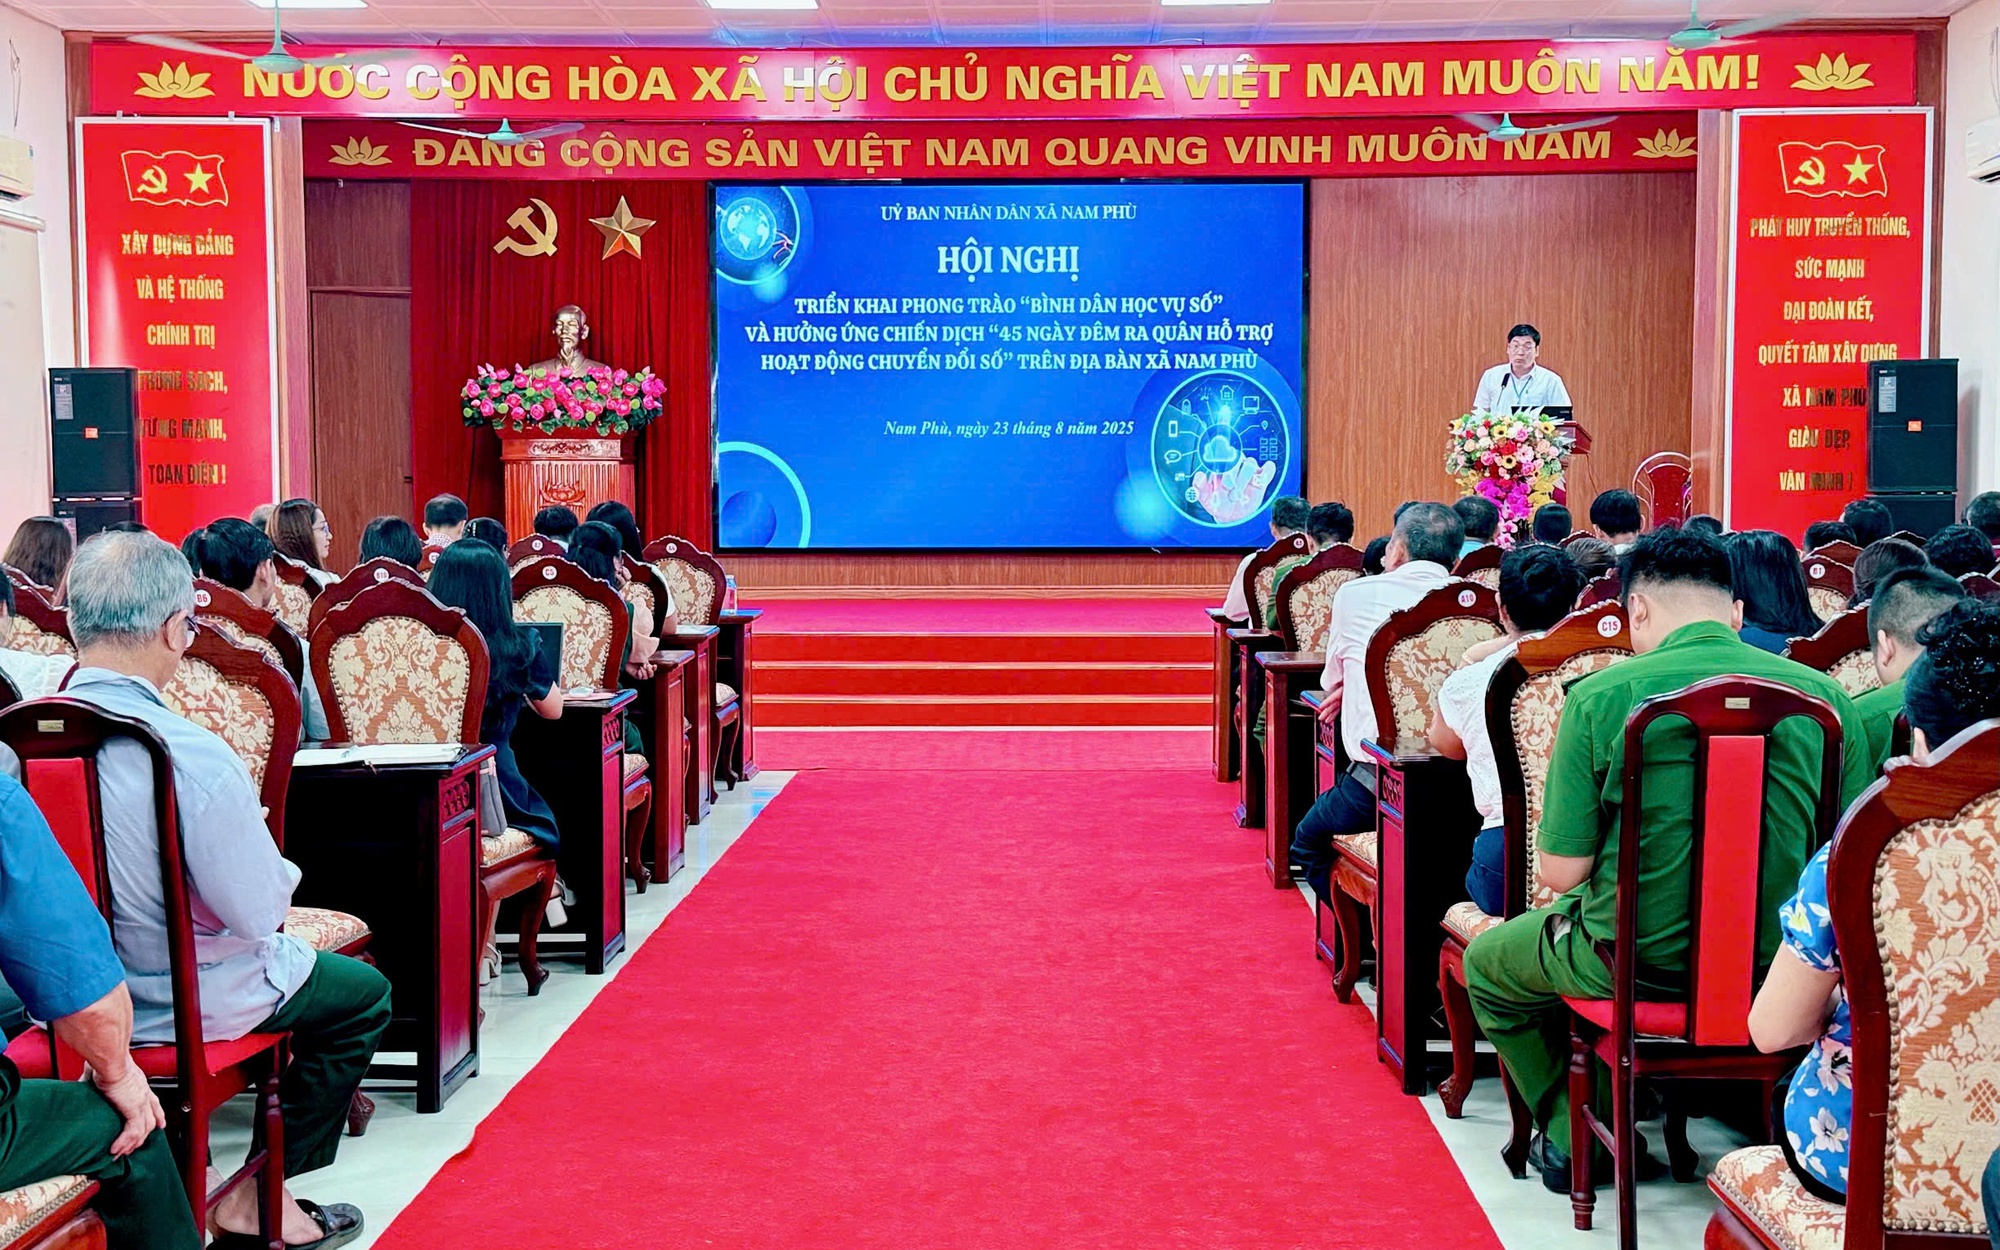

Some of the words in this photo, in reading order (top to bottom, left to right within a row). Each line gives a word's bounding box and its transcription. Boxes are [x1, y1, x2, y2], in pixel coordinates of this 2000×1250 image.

[405, 54, 552, 109] CỘNG
[568, 55, 676, 101] HÒA
[692, 55, 766, 102] XÃ
[783, 56, 867, 111] HỘI
[884, 52, 996, 102] CHỦ
[1006, 53, 1166, 101] NGHĨA
[1181, 53, 1291, 109] VIỆT
[1306, 62, 1424, 98] NAM
[1443, 48, 1599, 95] MUÔN
[1618, 47, 1760, 93] NĂM!
[560, 131, 690, 174] CỘNG
[705, 128, 798, 167] SẢN
[813, 132, 912, 173] VIỆT
[926, 138, 1029, 166] NAM
[1044, 136, 1208, 166] QUANG
[1223, 135, 1332, 164] VINH
[1347, 126, 1488, 163] MUÔN
[881, 203, 903, 221] UỶ
[906, 206, 940, 220] BAN
[944, 203, 991, 220] NHÂN
[995, 203, 1031, 220] DÂN
[1034, 203, 1057, 220] XÃ
[1061, 205, 1099, 220] NAM
[1103, 202, 1137, 220] PHÙ
[1750, 215, 1782, 237] PHÁT
[1786, 217, 1812, 237] HUY
[1815, 211, 1862, 236] TRUYỀN
[1866, 212, 1910, 238] THỐNG,
[121, 230, 149, 255] XÂY
[153, 232, 192, 259] DỰNG
[195, 228, 234, 255] ĐẢNG
[937, 236, 993, 283] HỘI
[1000, 246, 1080, 282] NGHỊ
[1795, 256, 1822, 278] SỨC
[1825, 259, 1865, 282] MẠNH
[136, 275, 154, 299] VÀ
[157, 275, 175, 303] HỆ
[179, 273, 224, 300] THỐNG
[794, 291, 850, 314] TRIỂN
[853, 297, 898, 314] KHAI
[901, 298, 964, 314] PHONG
[967, 292, 1016, 314] TRÀO
[1020, 292, 1075, 313] “BÌNH
[1079, 292, 1117, 313] DÂN
[1120, 297, 1157, 318] HỌC
[1160, 297, 1187, 318] VỤ
[1189, 291, 1223, 313] SỐ”
[1783, 301, 1805, 323] ĐẠI
[1808, 297, 1845, 321] ĐOÀN
[1848, 295, 1874, 322] KẾT,
[147, 321, 190, 346] CHÍNH
[193, 325, 216, 350] TRỊ
[745, 321, 771, 342] VÀ
[774, 320, 837, 342] HƯỞNG
[841, 320, 879, 342] ỨNG
[883, 320, 938, 342] CHIẾN
[942, 325, 985, 346] DỊCH
[988, 324, 1022, 341] “45
[1026, 320, 1077, 341] NGÀY
[1080, 320, 1120, 341] ĐÊM
[1124, 326, 1149, 341] RA
[1152, 320, 1203, 345] QUÂN
[1206, 317, 1232, 341] HỖ
[1236, 322, 1274, 346] TRỢ
[761, 354, 811, 375] HOẠT
[814, 350, 864, 375] ĐỘNG
[868, 347, 941, 370] CHUYỂN
[944, 347, 976, 370] ĐỔI
[980, 348, 1014, 370] SỐ”
[1017, 350, 1066, 370] TRÊN
[1070, 353, 1101, 374] ĐỊA
[1104, 348, 1143, 369] BÀN
[1145, 350, 1171, 369] XÃ
[1174, 353, 1216, 369] NAM
[1220, 348, 1258, 369] PHÙ
[1758, 339, 1800, 366] QUYẾT
[1802, 341, 1830, 363] TÂM
[1832, 341, 1859, 363] XÂY
[138, 371, 182, 391] TRONG
[1782, 384, 1801, 407] XÃ
[1806, 387, 1837, 407] NAM
[884, 421, 916, 435] Nam
[920, 421, 952, 437] Phù,
[956, 420, 989, 438] ngày
[992, 421, 1009, 435] 23
[1012, 420, 1051, 438] tháng
[1055, 421, 1064, 435] 8
[1067, 421, 1097, 435] năm
[1101, 421, 1134, 435] 2025
[1788, 426, 1819, 449] GIÀU
[1779, 469, 1805, 491] VĂN
[1461, 594, 1474, 604] A10
[1601, 620, 1618, 632] C15
